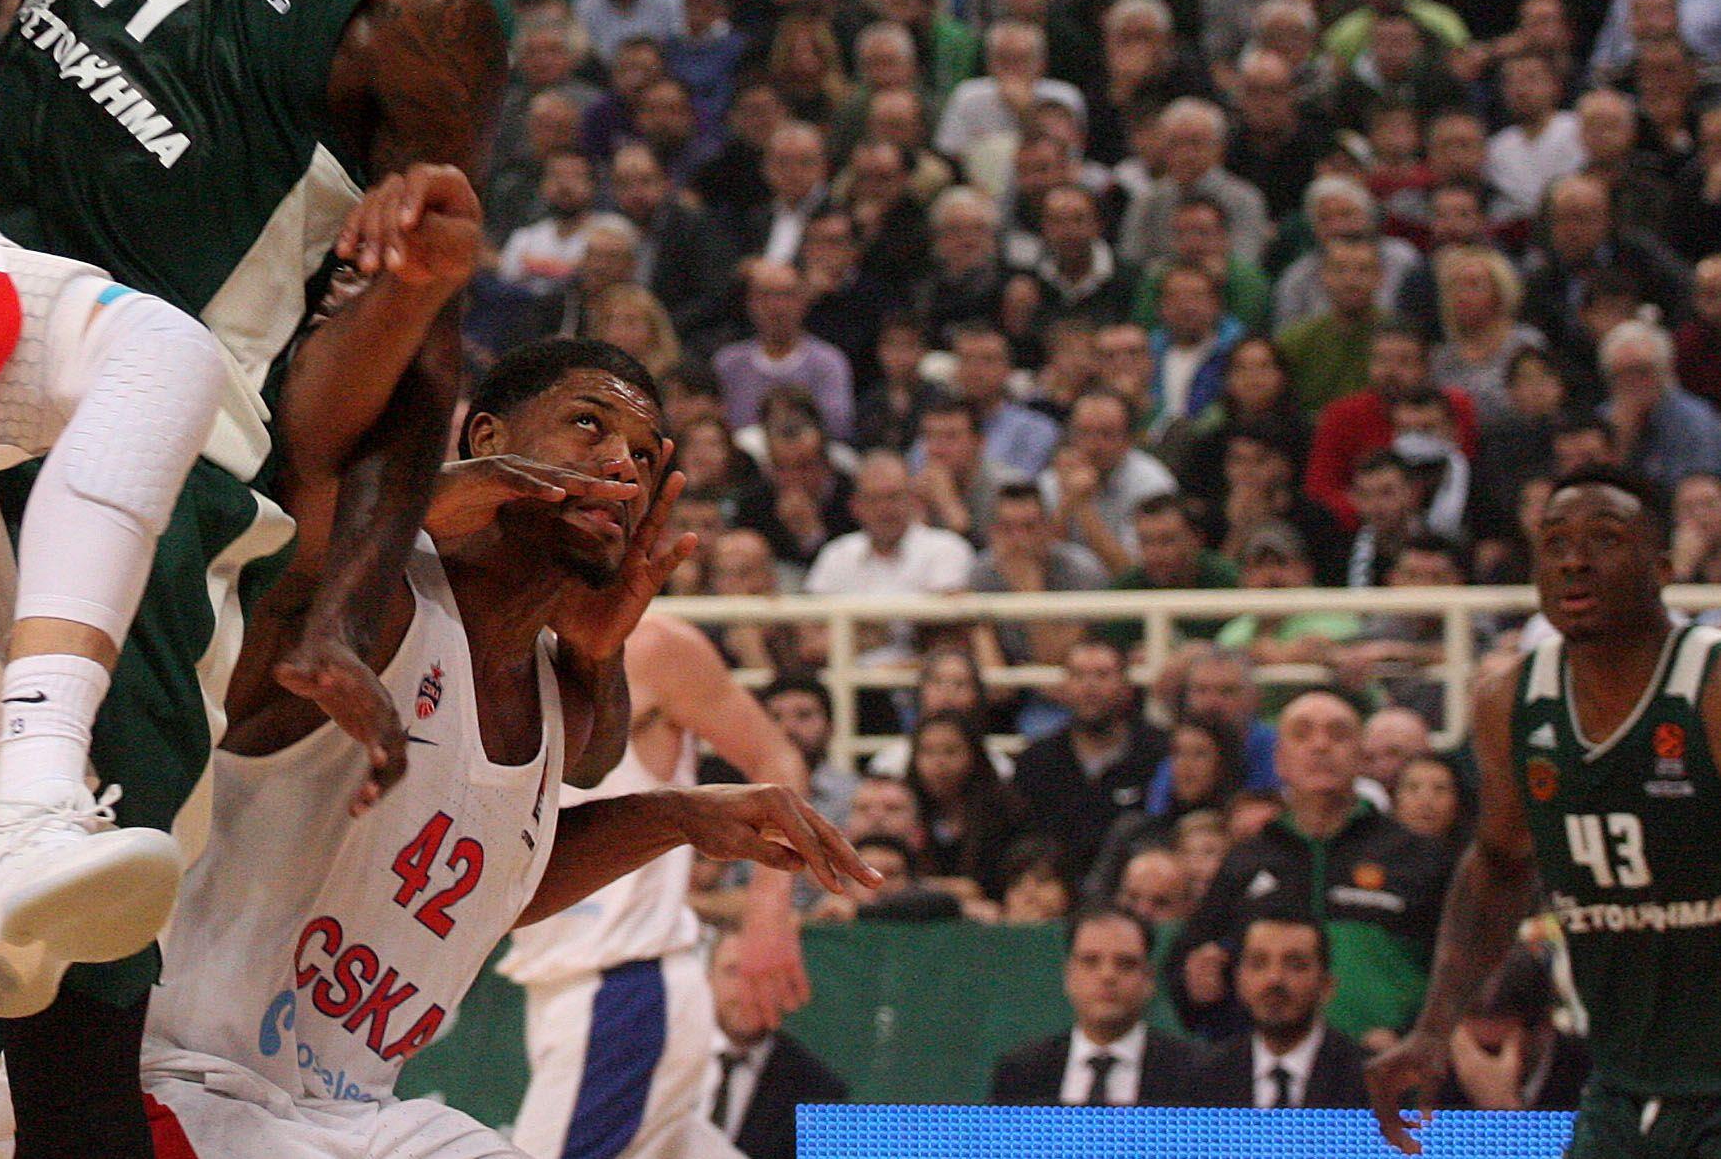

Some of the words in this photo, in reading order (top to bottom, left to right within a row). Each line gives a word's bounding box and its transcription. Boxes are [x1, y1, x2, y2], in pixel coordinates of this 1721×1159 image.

[391, 809, 484, 940] 42
[1564, 812, 1652, 889] 43
[293, 915, 446, 1063] CSKA
